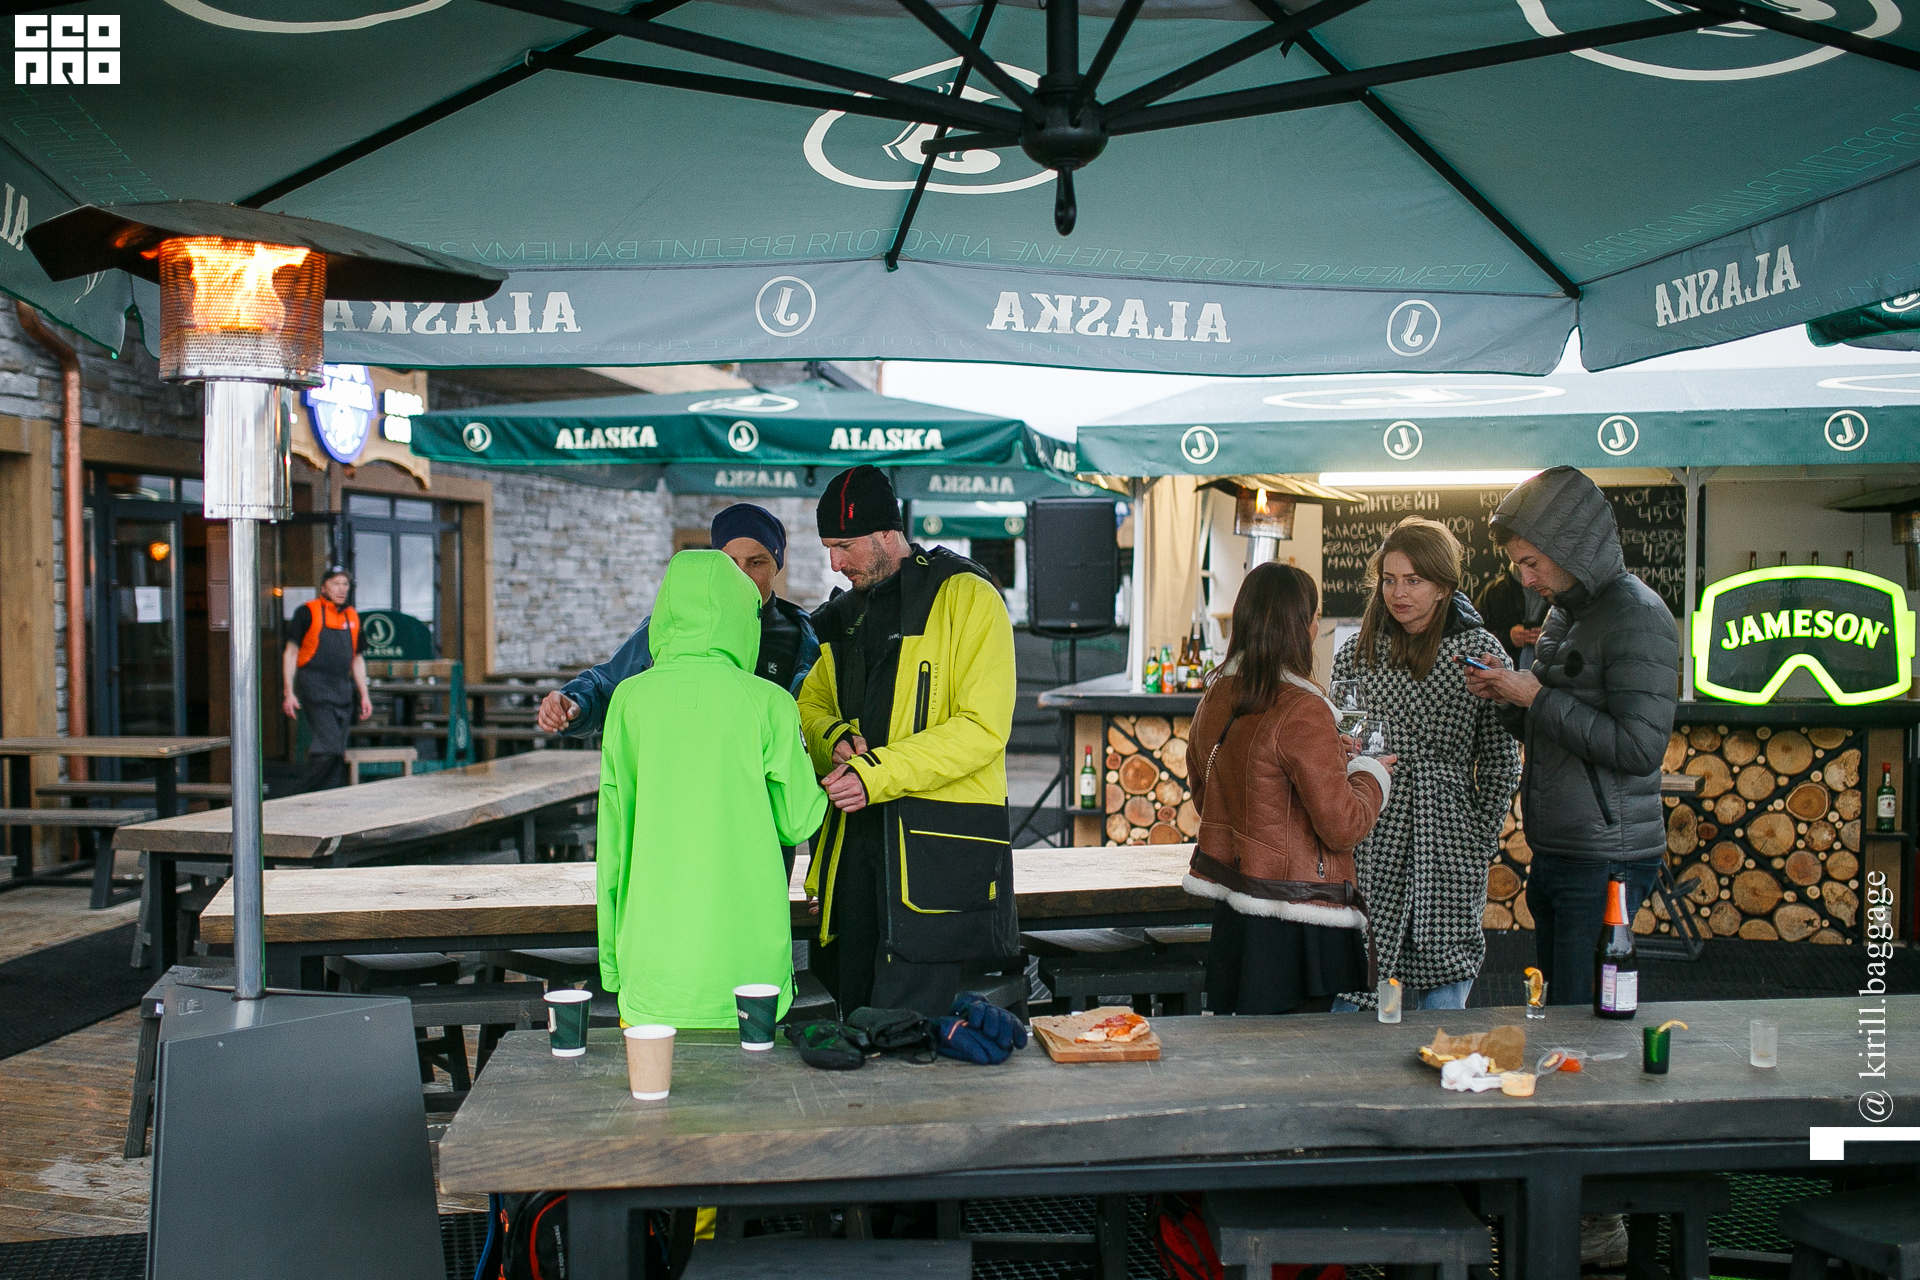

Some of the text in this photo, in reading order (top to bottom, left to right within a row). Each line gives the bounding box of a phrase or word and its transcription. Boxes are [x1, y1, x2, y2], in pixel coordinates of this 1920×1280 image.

[556, 426, 658, 450] ALASKA
[830, 427, 944, 452] ALASKA
[1335, 491, 1439, 517] ИНТВЕЙН
[1720, 608, 1888, 651] JAMESON
